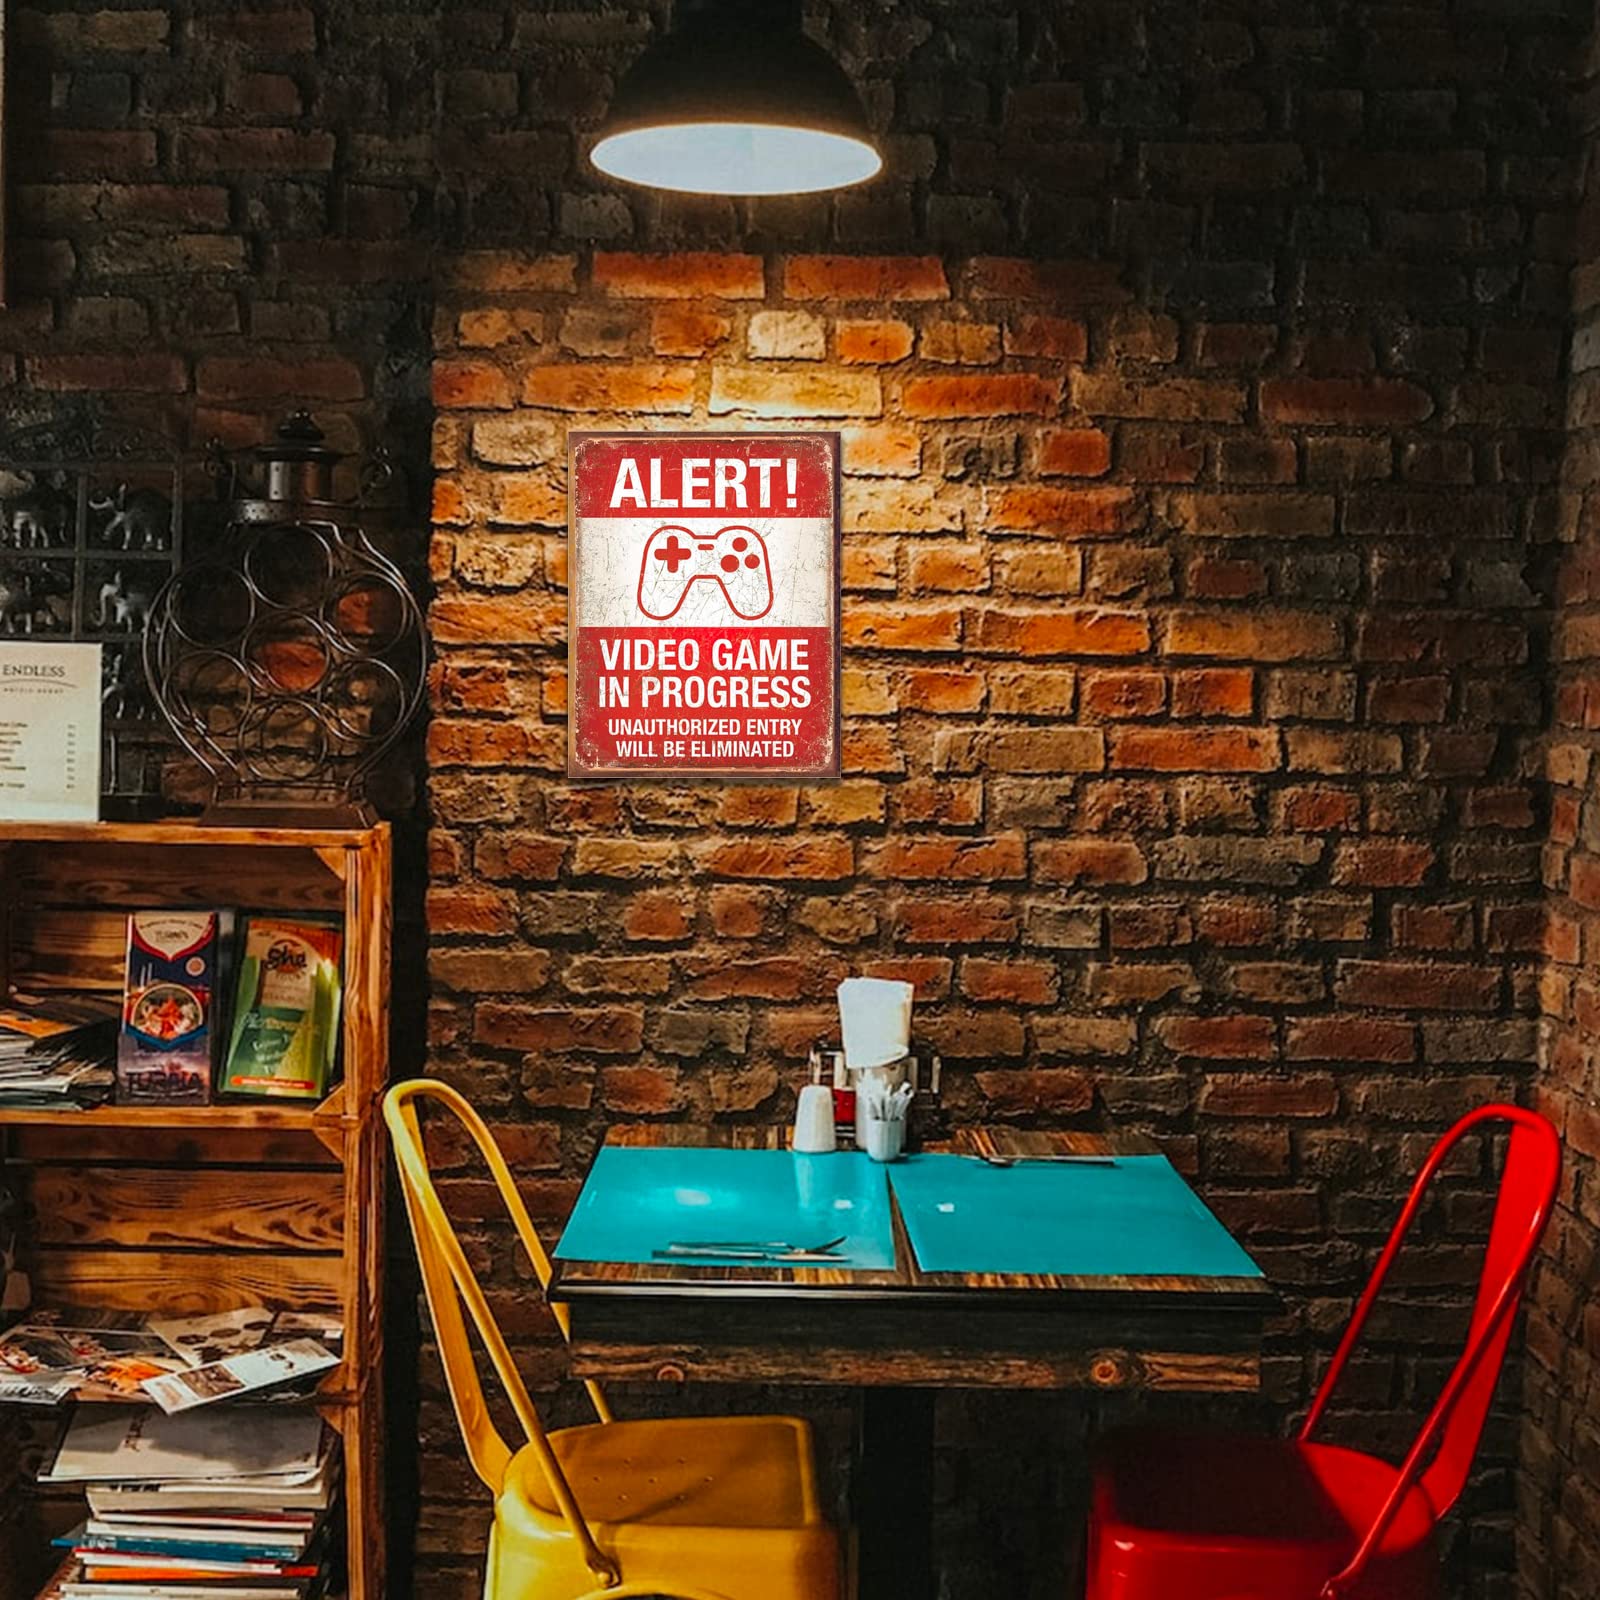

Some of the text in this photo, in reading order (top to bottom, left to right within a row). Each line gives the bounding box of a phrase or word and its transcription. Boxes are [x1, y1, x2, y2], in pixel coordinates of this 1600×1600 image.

[610, 458, 798, 508] ALERT!
[600, 639, 809, 671] VIDEO GAME
[3, 664, 66, 678] ENDLESS
[598, 676, 811, 709] IN PROGRESS
[608, 719, 801, 736] UNAUTHORIZED ENTRY
[616, 740, 794, 757] WILL BE ELIMINATED
